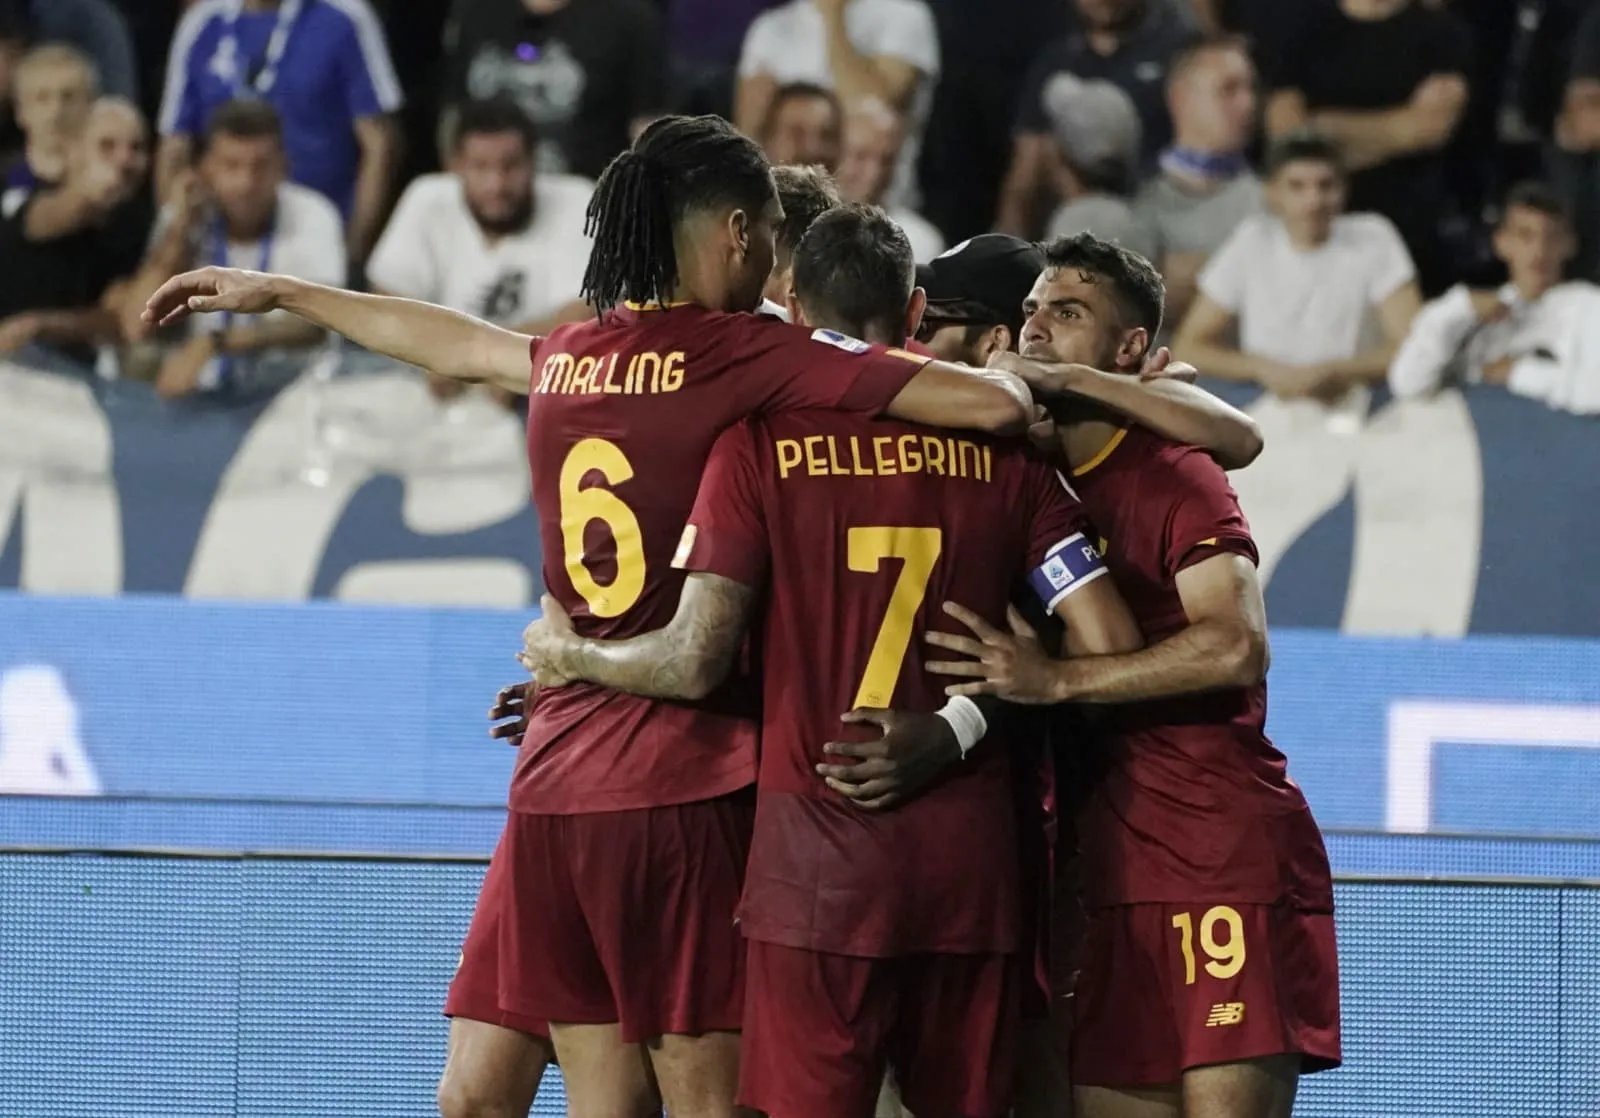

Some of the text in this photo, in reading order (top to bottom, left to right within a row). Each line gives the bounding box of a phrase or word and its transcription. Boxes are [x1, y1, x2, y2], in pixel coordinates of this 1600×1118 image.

[534, 351, 685, 395] SMALLING
[776, 433, 992, 482] PELLEGRINI
[559, 437, 646, 619] 6
[847, 526, 942, 710] 7
[1172, 905, 1246, 985] 19
